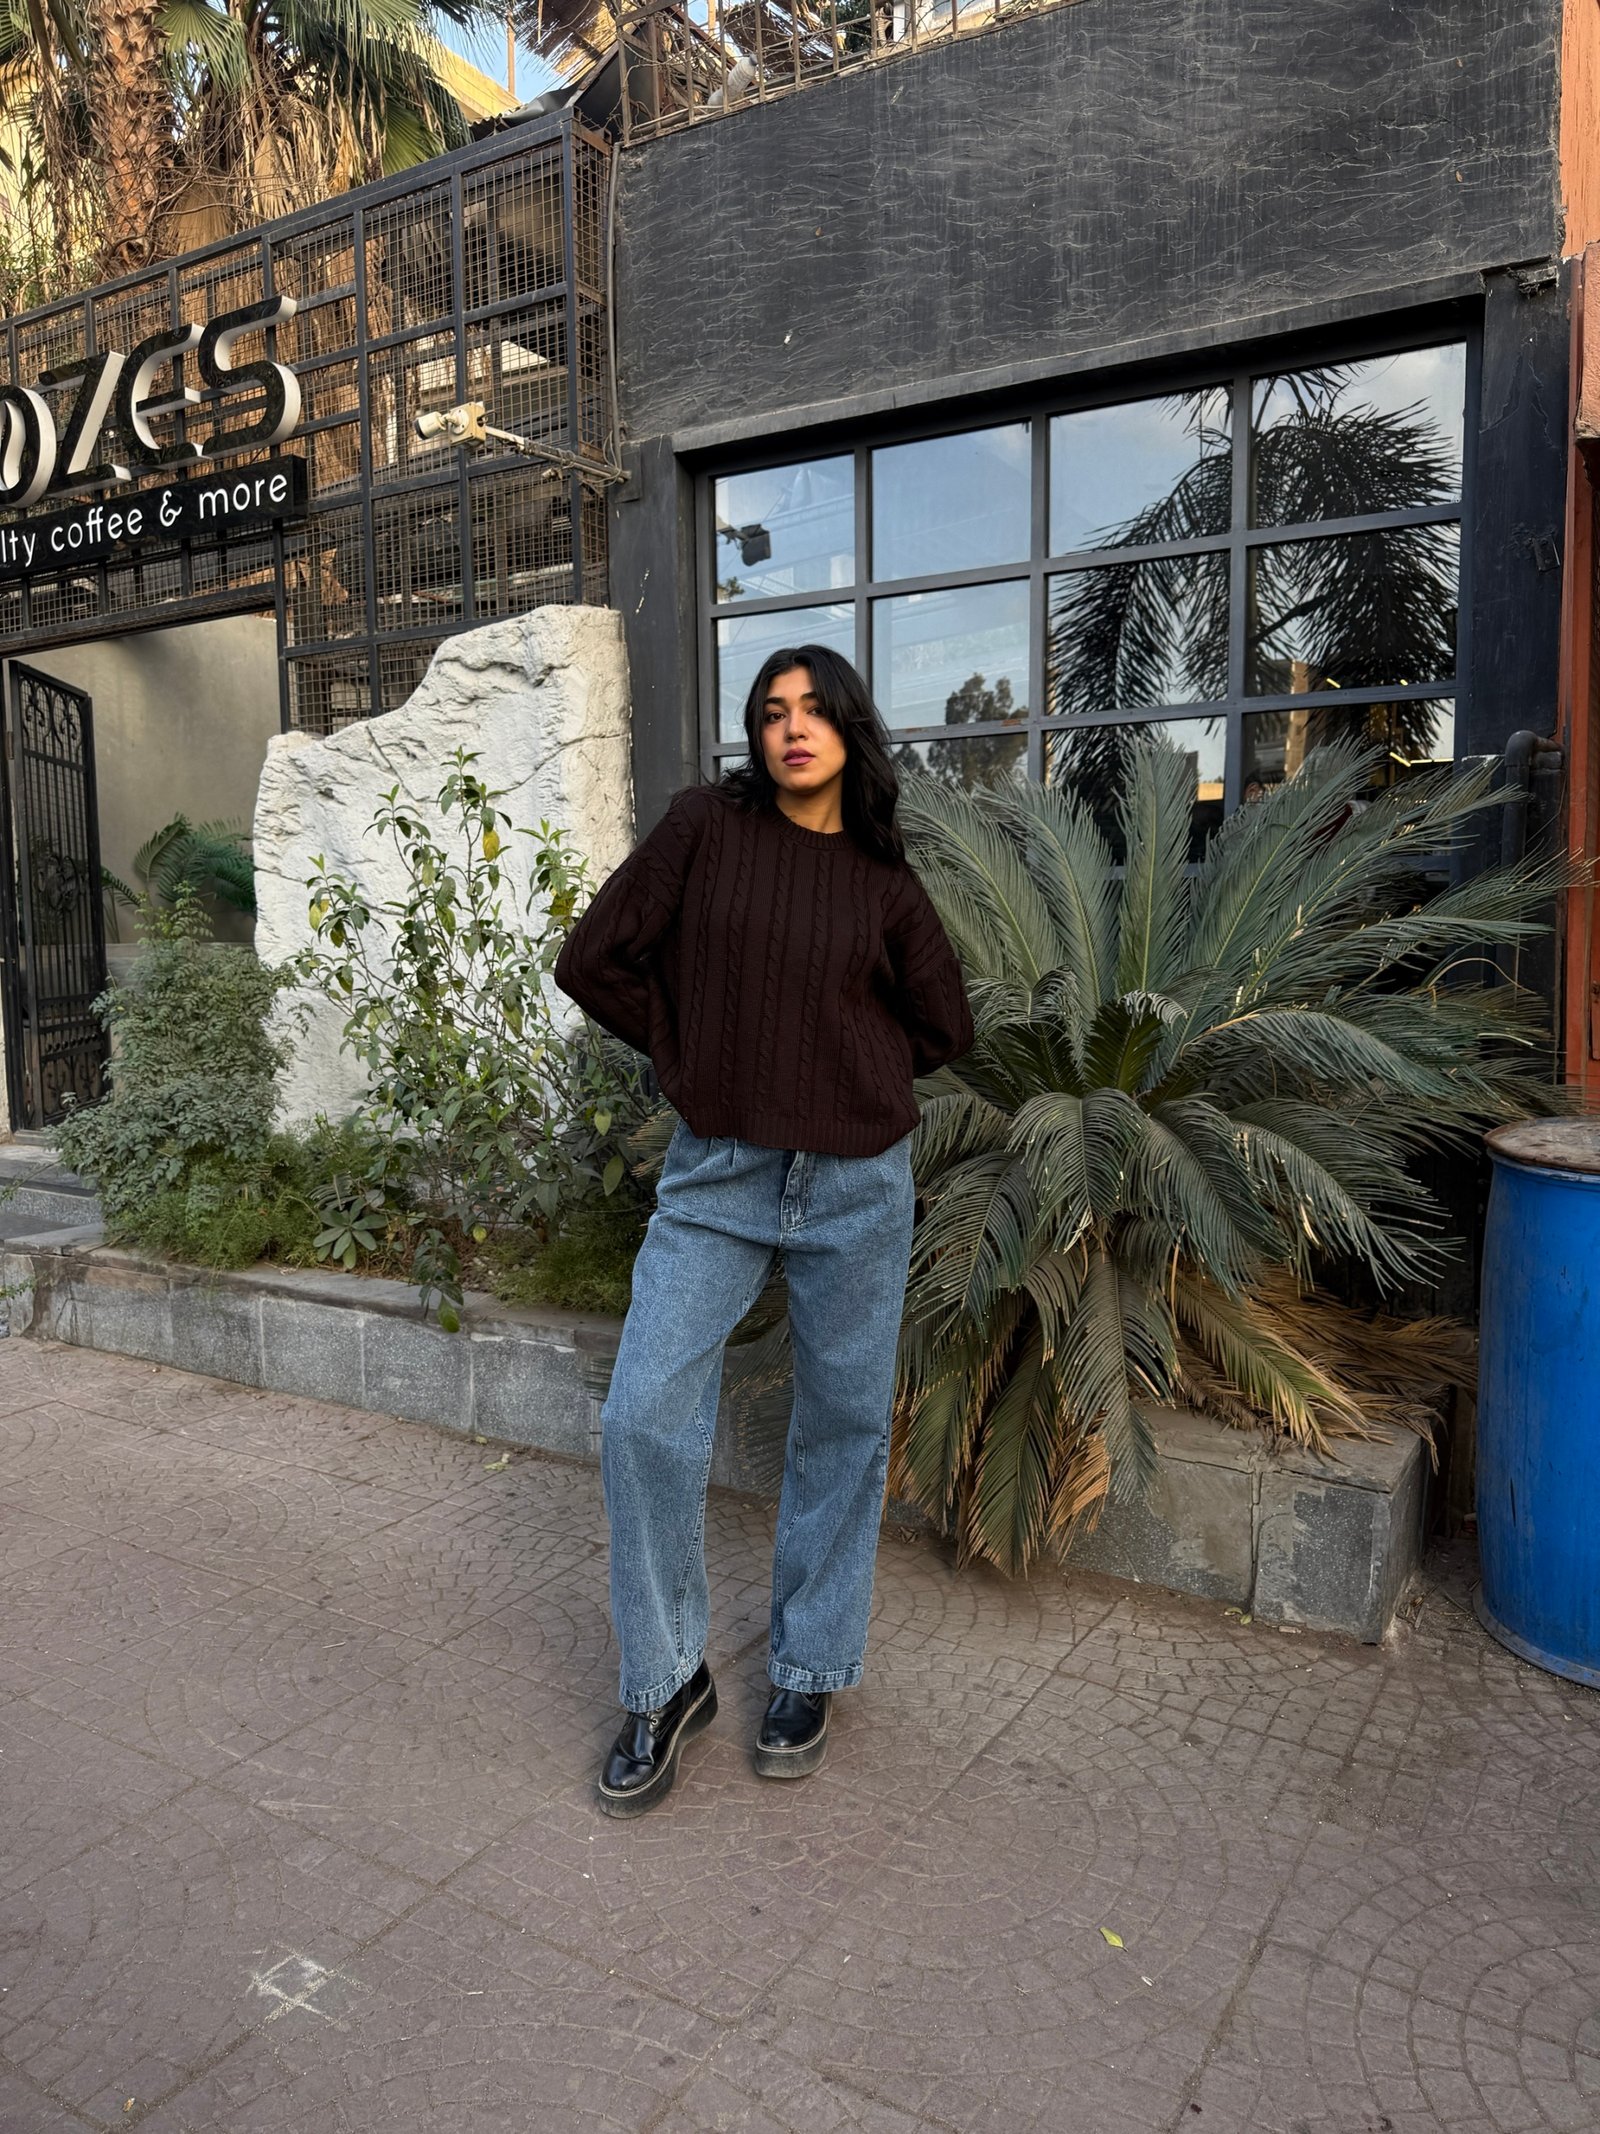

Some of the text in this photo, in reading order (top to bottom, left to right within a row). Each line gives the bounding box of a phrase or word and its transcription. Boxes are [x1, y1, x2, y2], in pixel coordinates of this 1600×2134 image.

[50, 505, 143, 552] coffee
[159, 490, 183, 527] &
[198, 474, 288, 519] more
